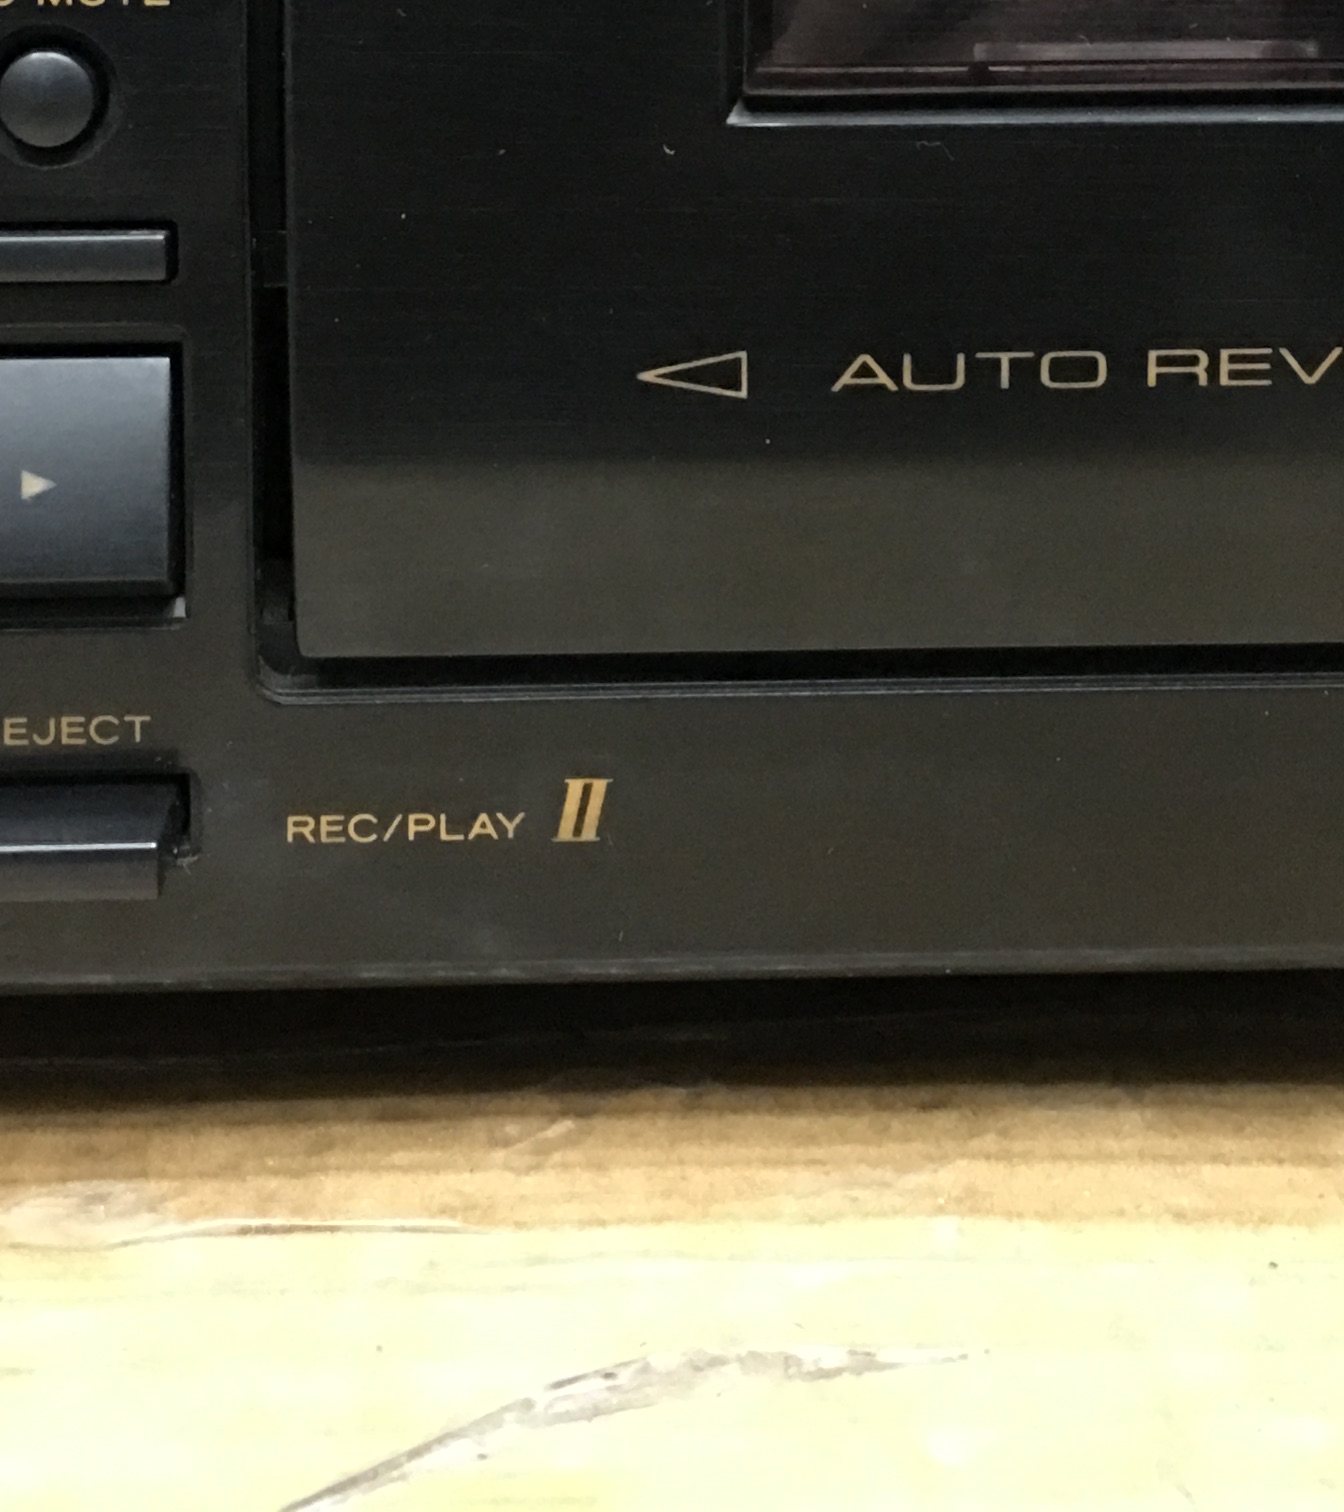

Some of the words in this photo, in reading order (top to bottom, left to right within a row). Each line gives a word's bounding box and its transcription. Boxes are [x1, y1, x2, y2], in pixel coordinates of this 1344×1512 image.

[831, 350, 1108, 392] AUTO
[3, 714, 151, 746] EJECT
[286, 812, 525, 844] REC/PLAY
[555, 778, 612, 842] II
